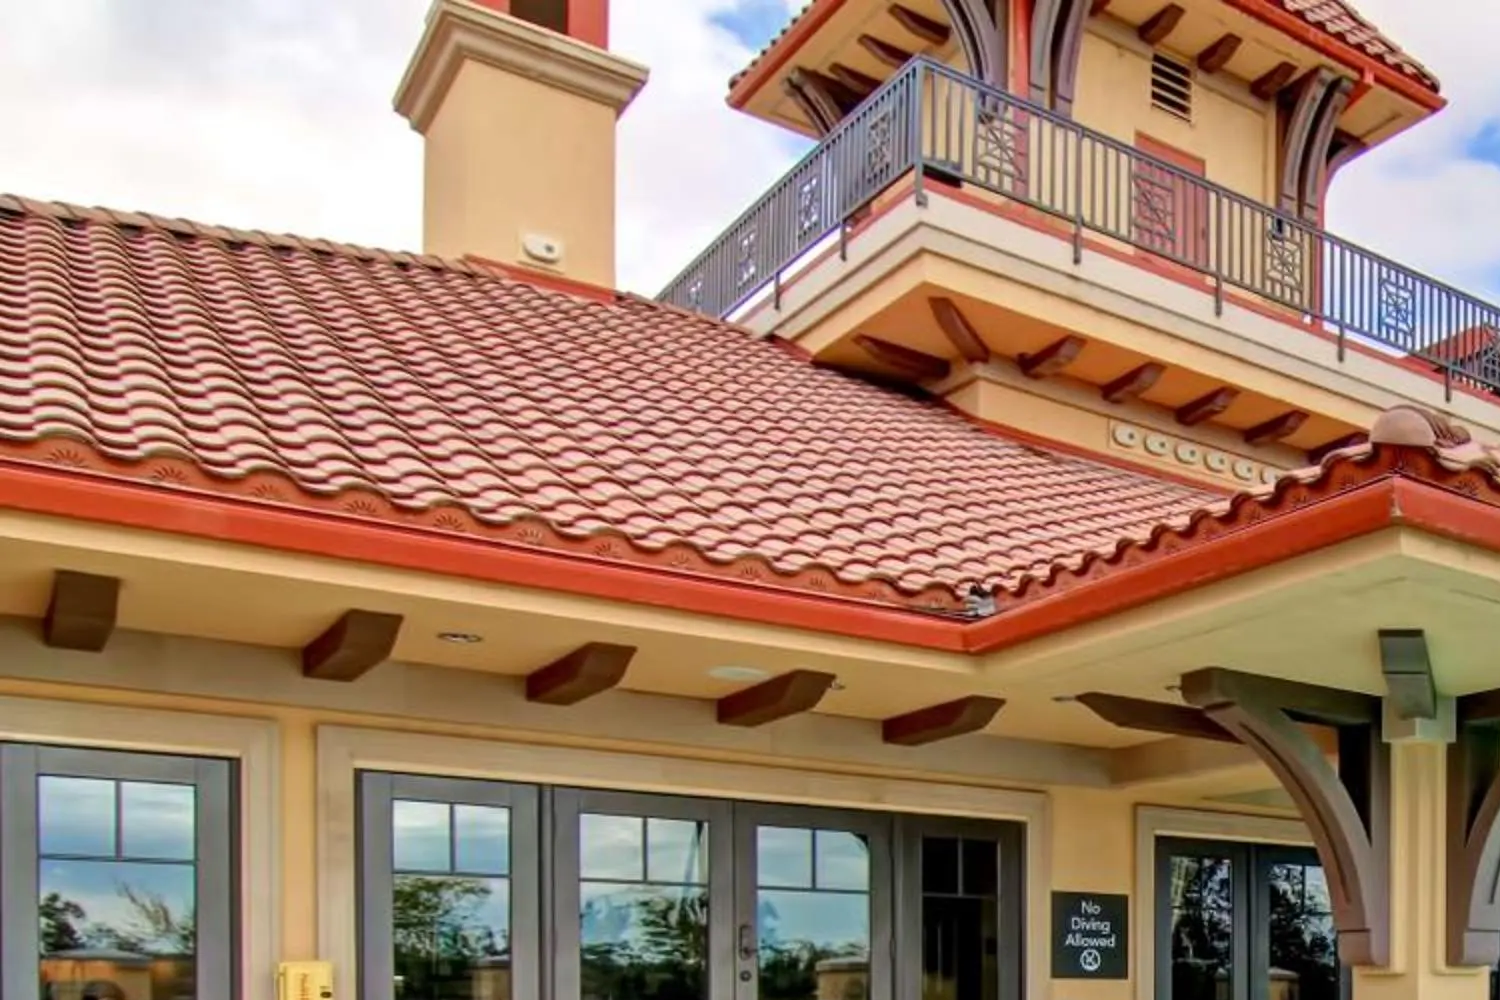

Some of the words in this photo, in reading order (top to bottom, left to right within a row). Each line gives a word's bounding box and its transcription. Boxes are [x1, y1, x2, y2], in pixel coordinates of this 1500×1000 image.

[1081, 900, 1101, 914] No
[1071, 917, 1111, 934] Diving
[1064, 933, 1116, 947] Allowed
